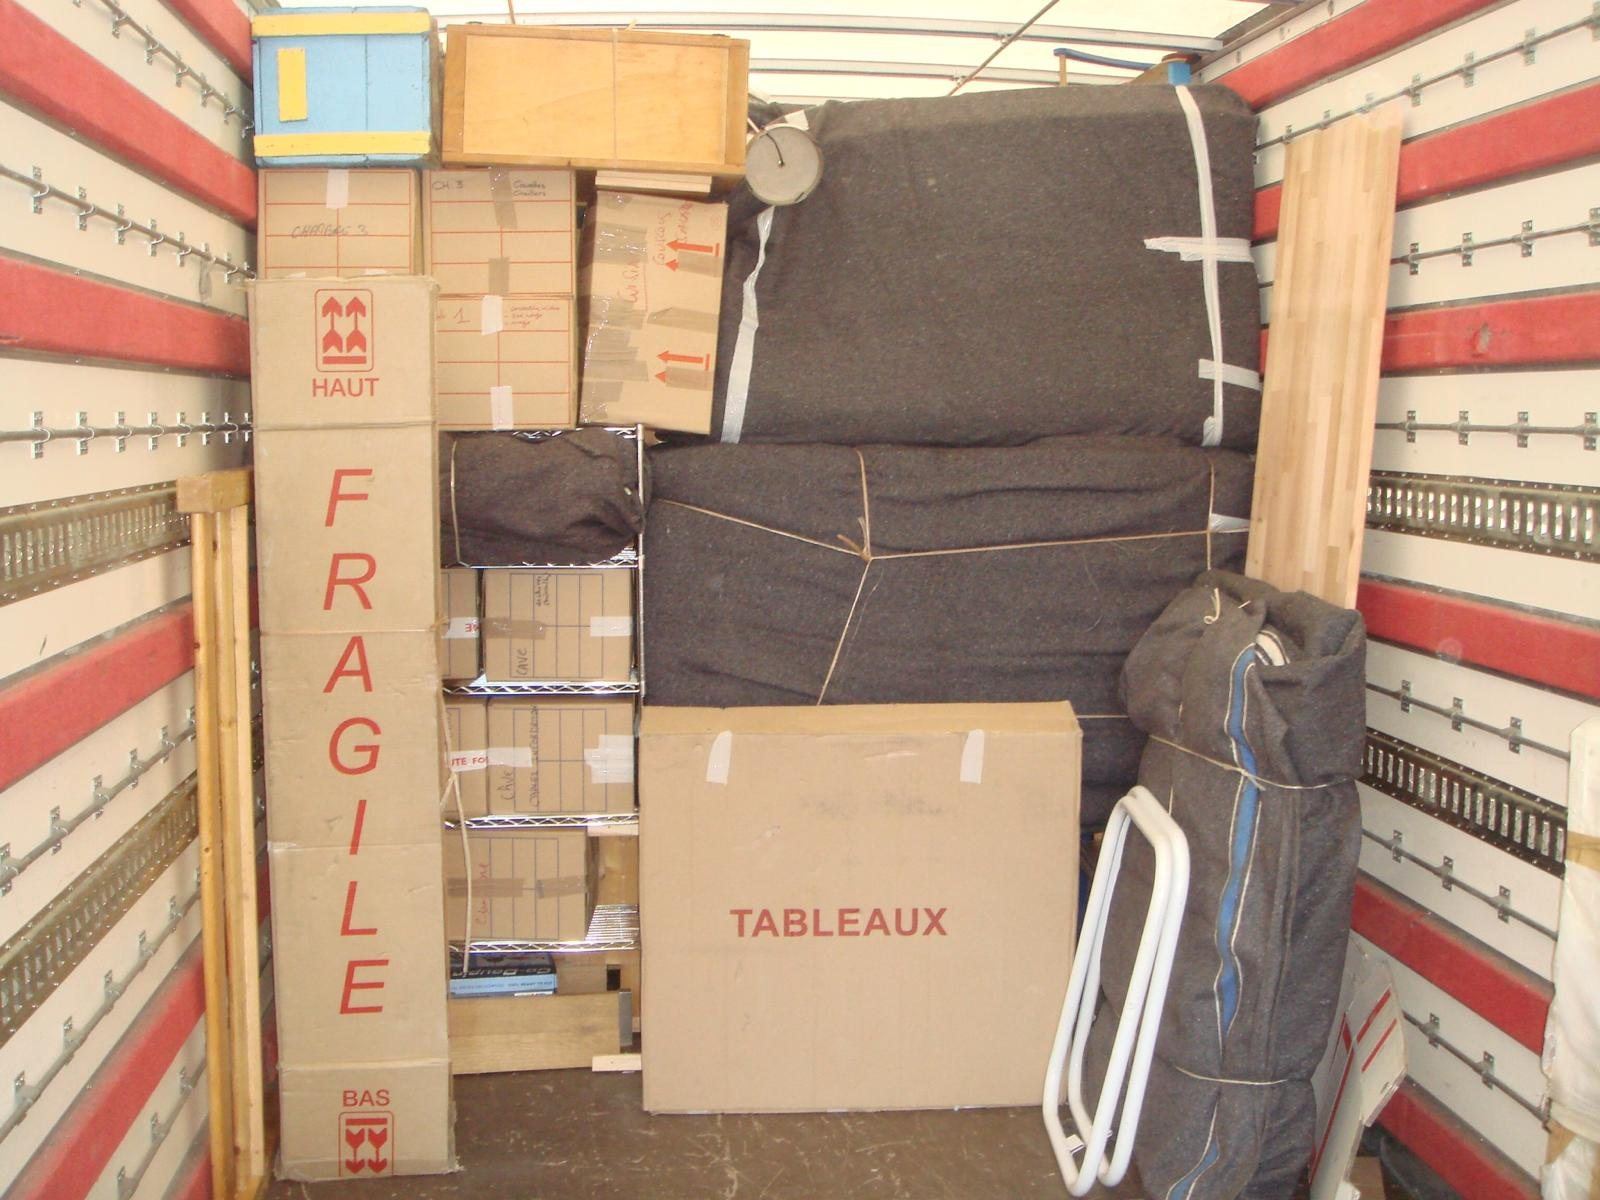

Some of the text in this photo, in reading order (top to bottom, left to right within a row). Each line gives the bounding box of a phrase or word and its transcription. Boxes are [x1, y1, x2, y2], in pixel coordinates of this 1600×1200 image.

[311, 376, 380, 399] HAUT
[322, 467, 391, 1017] FRAGILE
[731, 907, 947, 938] TABLEAUX
[343, 1088, 389, 1109] BAS
